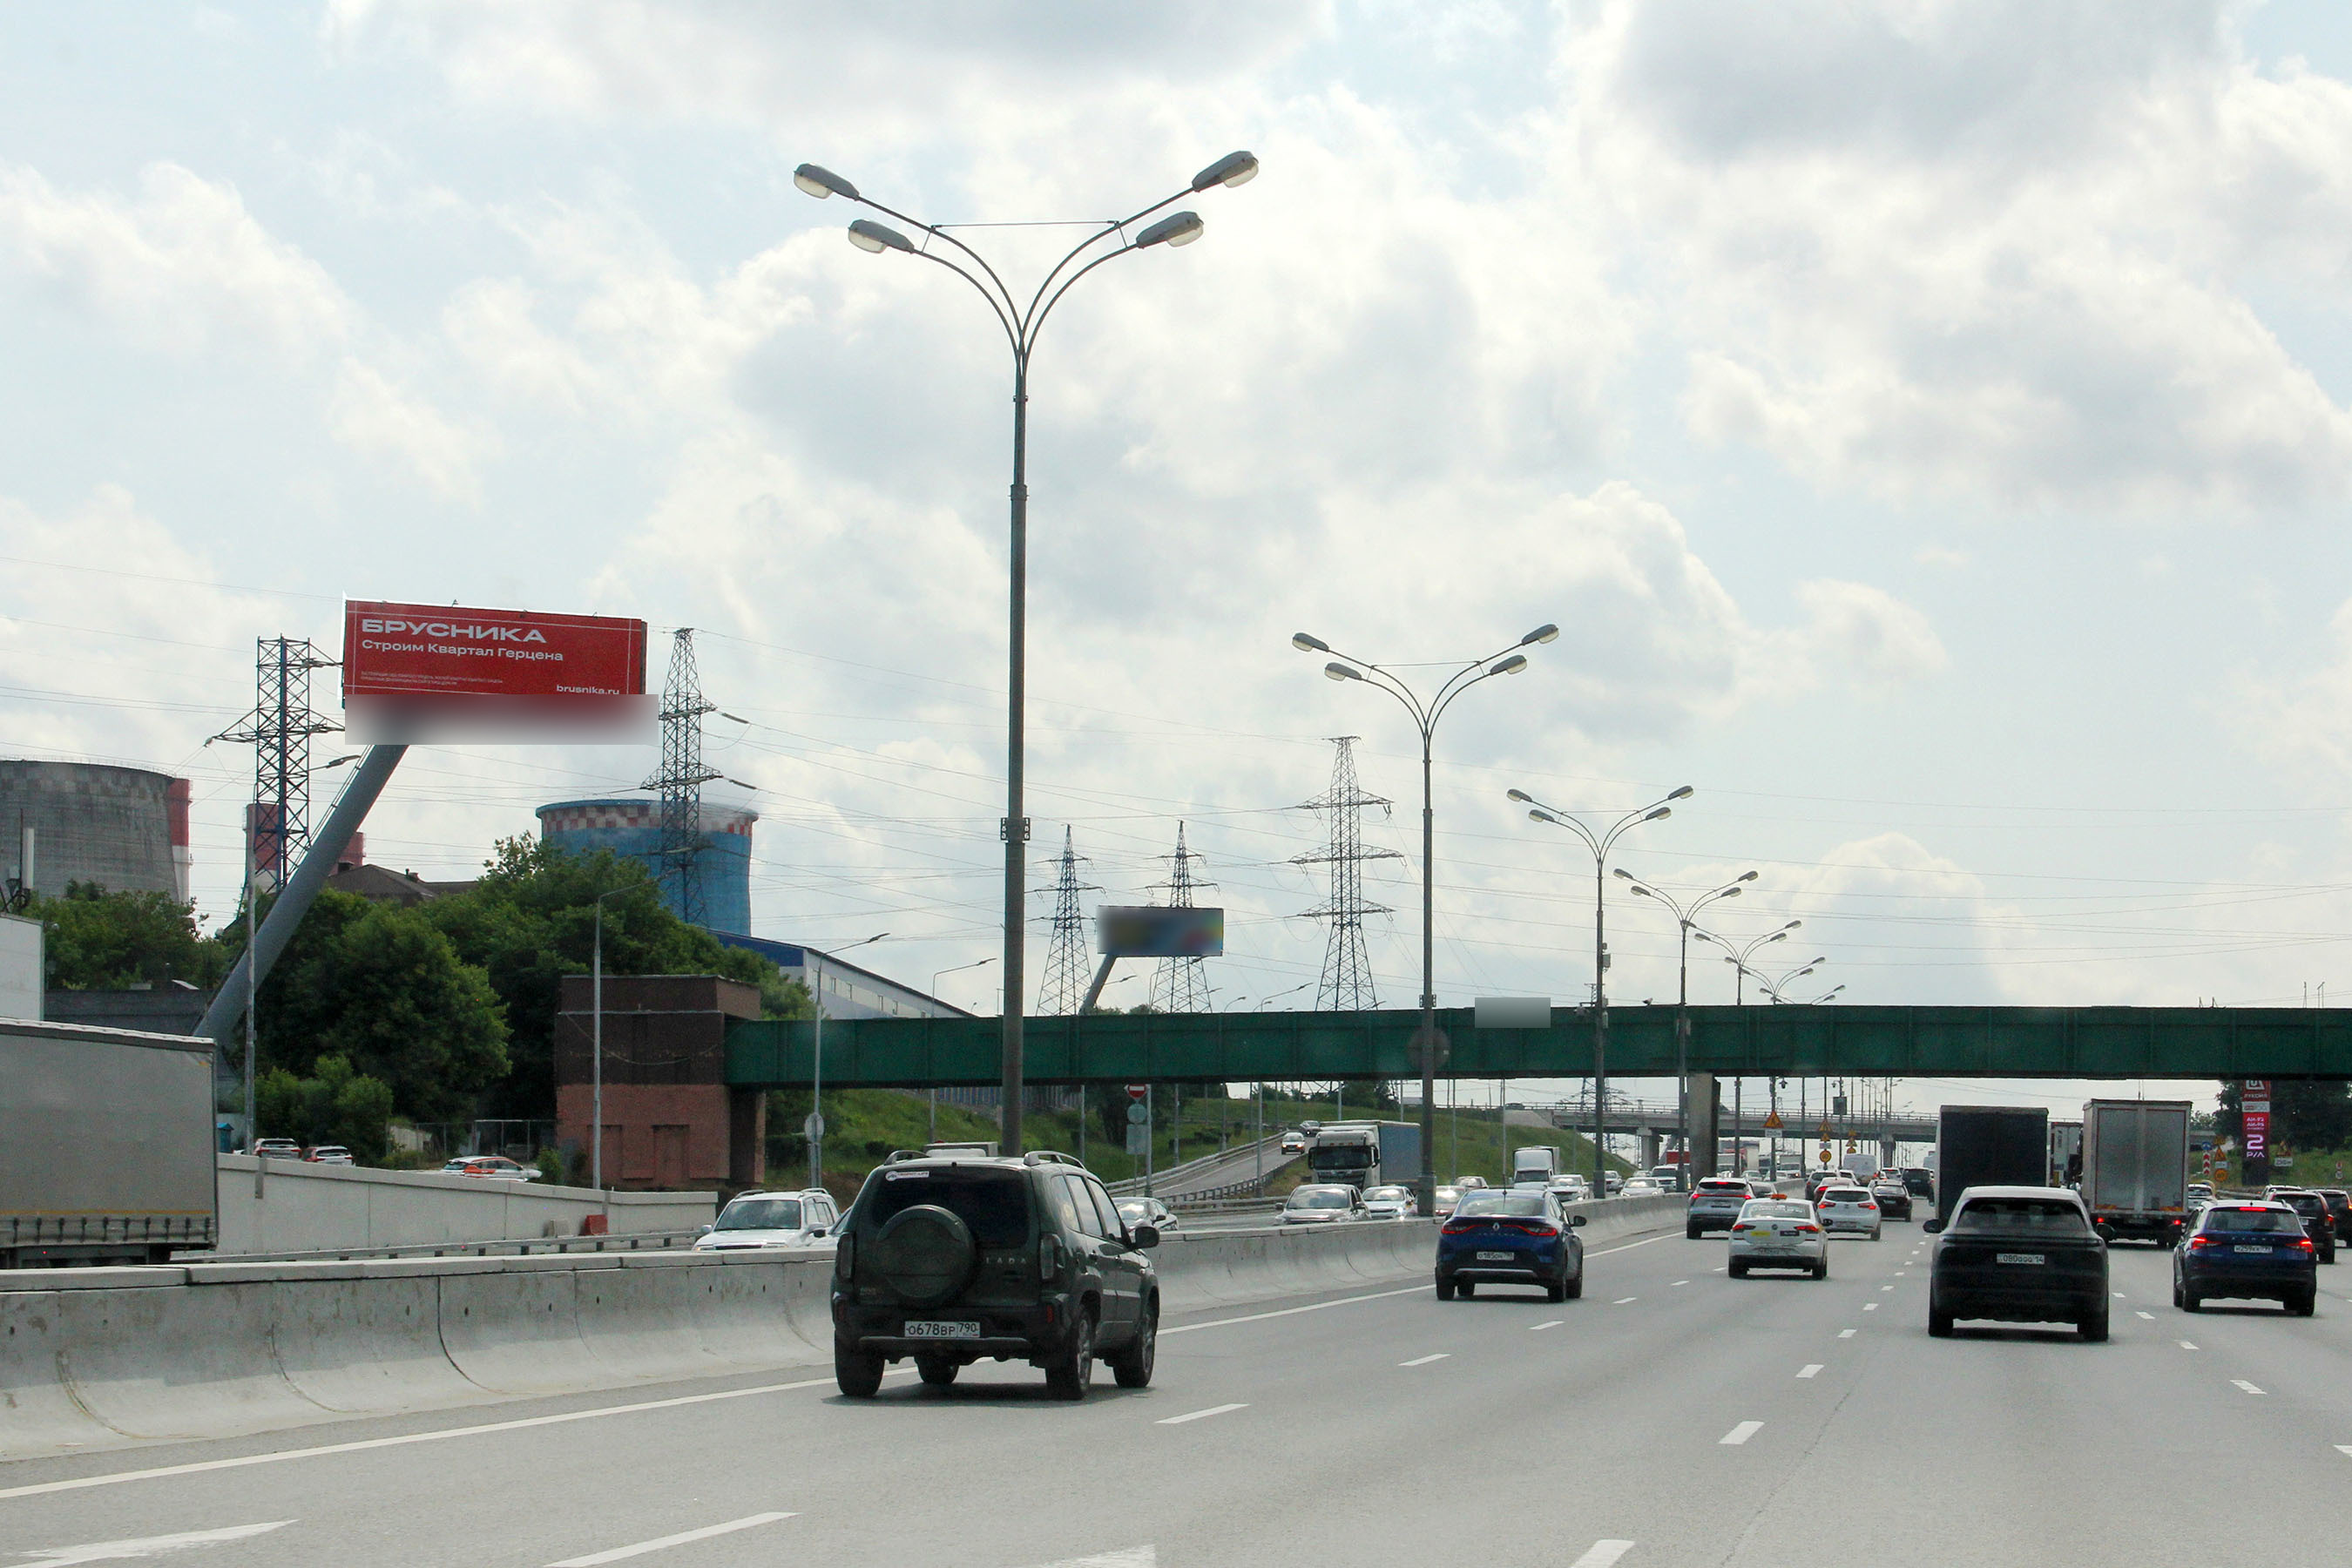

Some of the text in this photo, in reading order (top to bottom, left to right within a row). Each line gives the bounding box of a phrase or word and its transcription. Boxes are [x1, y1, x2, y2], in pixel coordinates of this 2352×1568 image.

[362, 618, 547, 644] БРУСНИКА
[362, 639, 564, 661] Строим Квартал Герцена
[556, 684, 620, 695] brusnika.ru
[2247, 1134, 2264, 1150] 2
[908, 1322, 977, 1336] О678ВР 790
